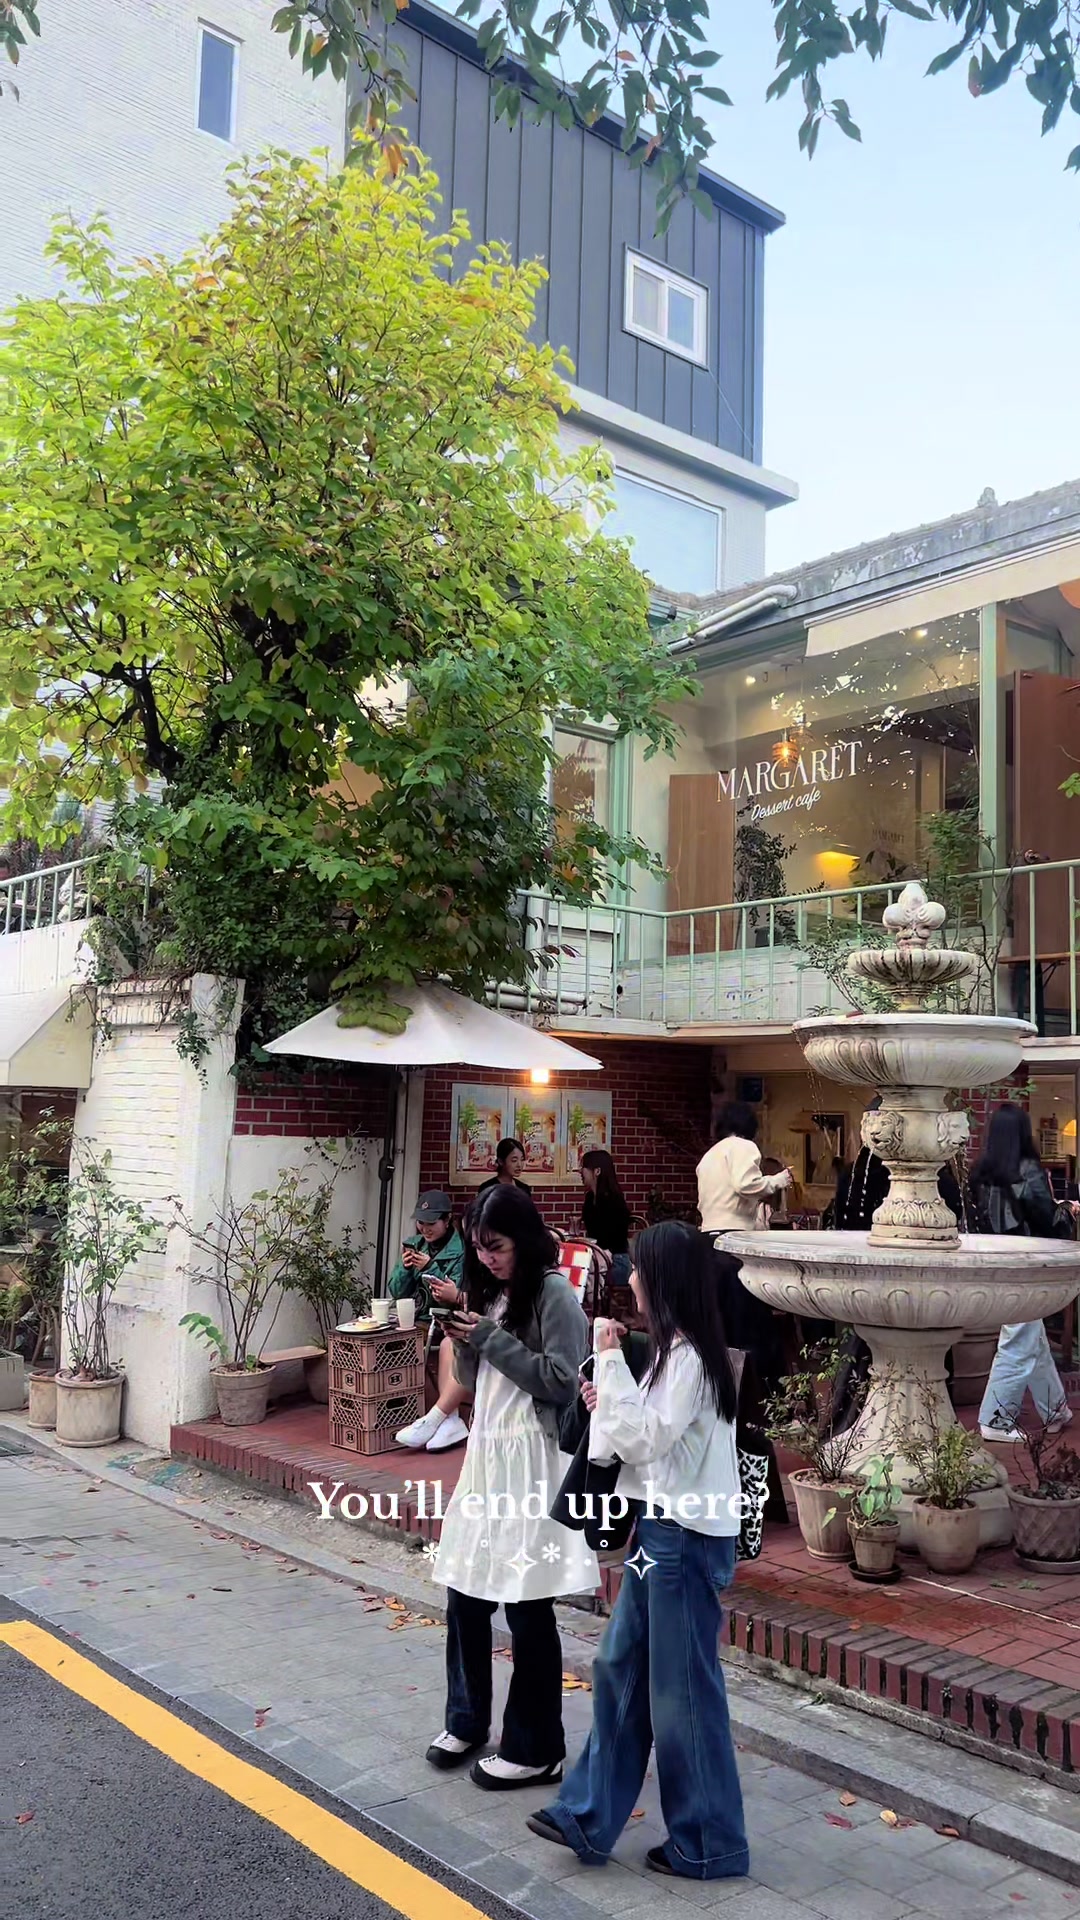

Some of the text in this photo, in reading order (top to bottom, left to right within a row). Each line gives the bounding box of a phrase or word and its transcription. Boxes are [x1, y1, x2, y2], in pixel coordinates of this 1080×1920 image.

[717, 740, 863, 802] MARGARET
[751, 786, 821, 821] Dessert cafe
